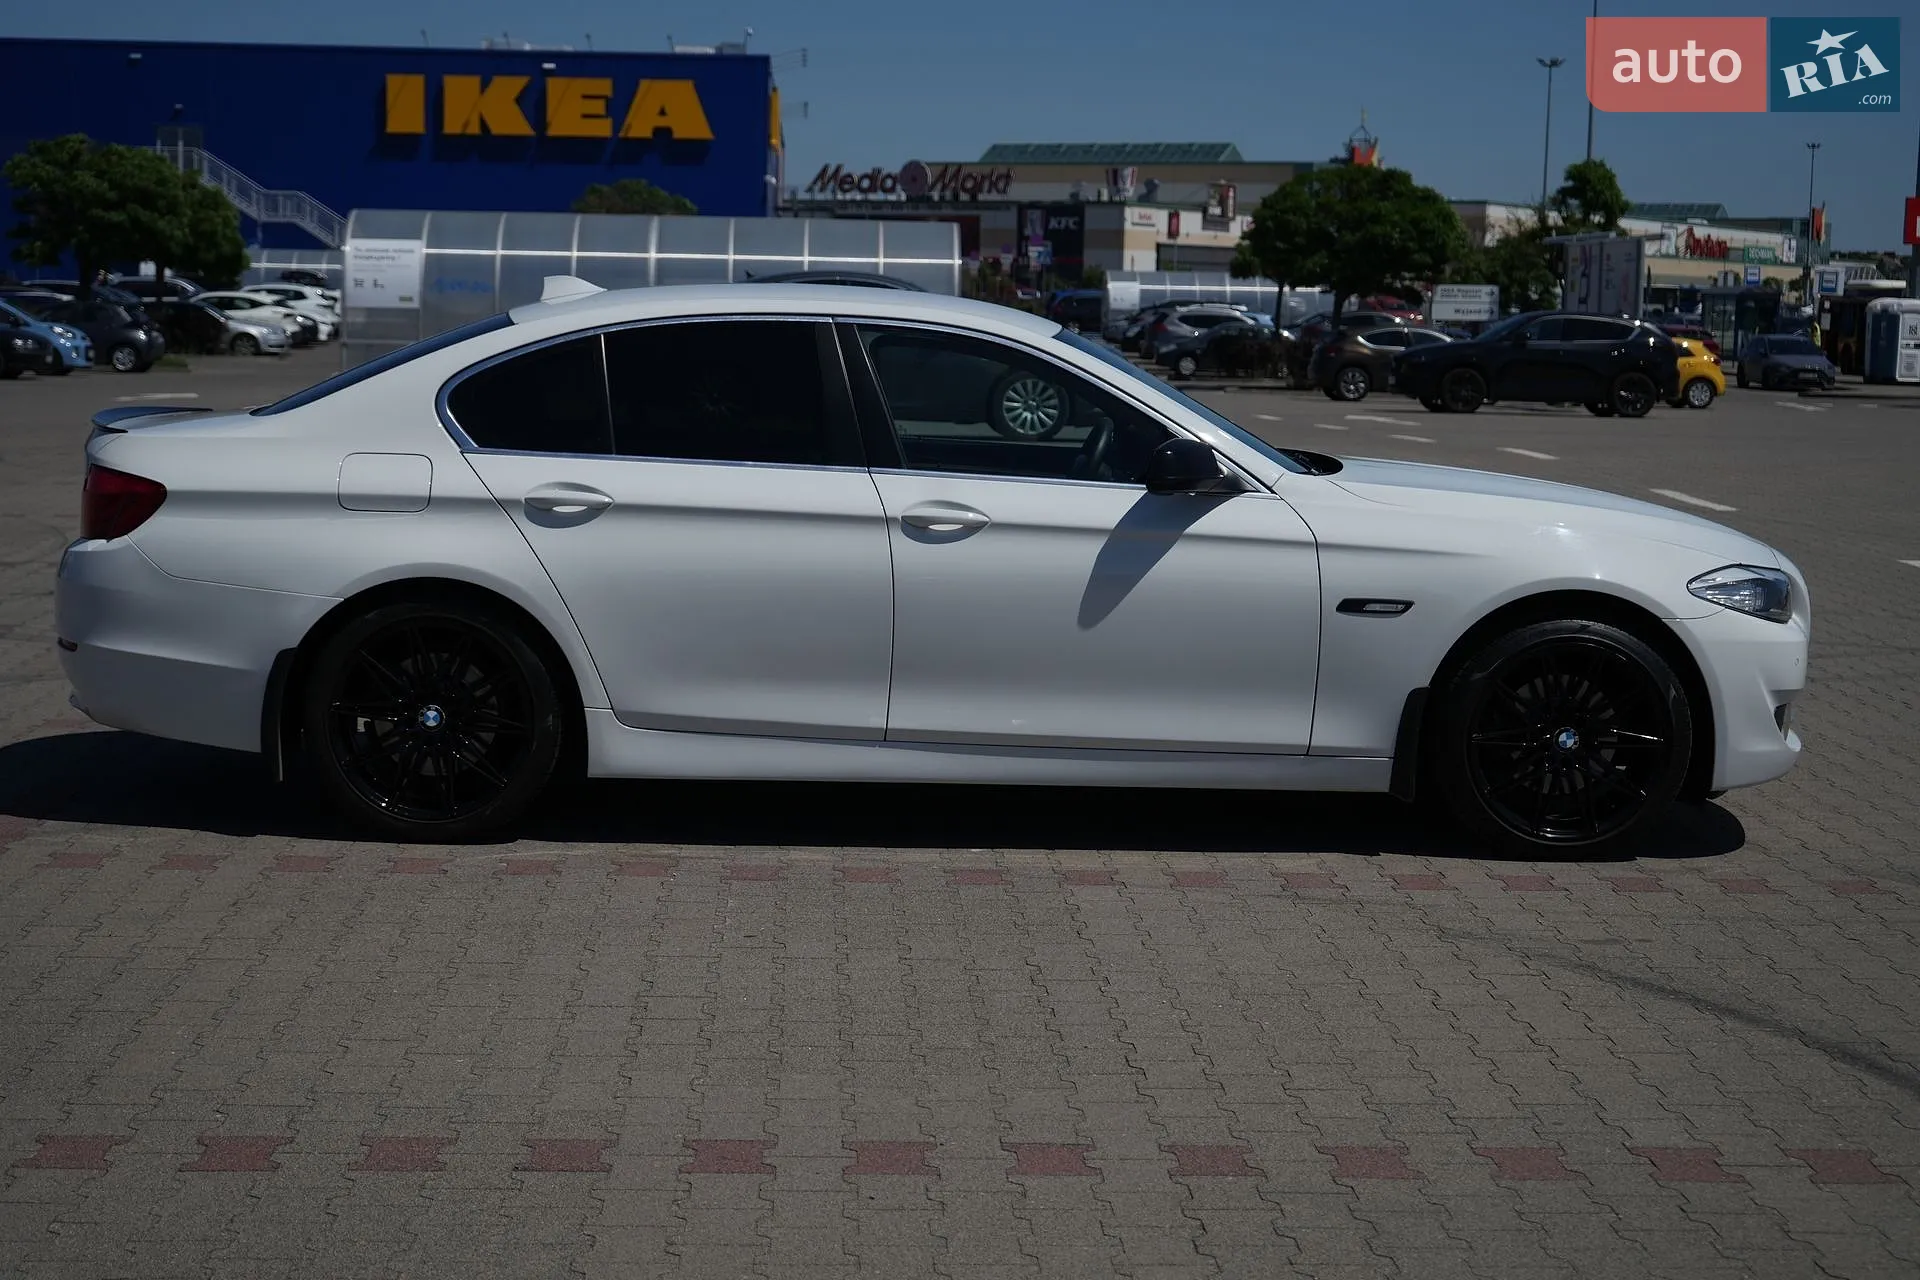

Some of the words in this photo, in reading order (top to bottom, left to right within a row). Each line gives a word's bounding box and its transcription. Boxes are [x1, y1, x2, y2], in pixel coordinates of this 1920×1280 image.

[385, 73, 715, 140] IKEA
[805, 163, 900, 194] Media
[928, 164, 1016, 195] Markt
